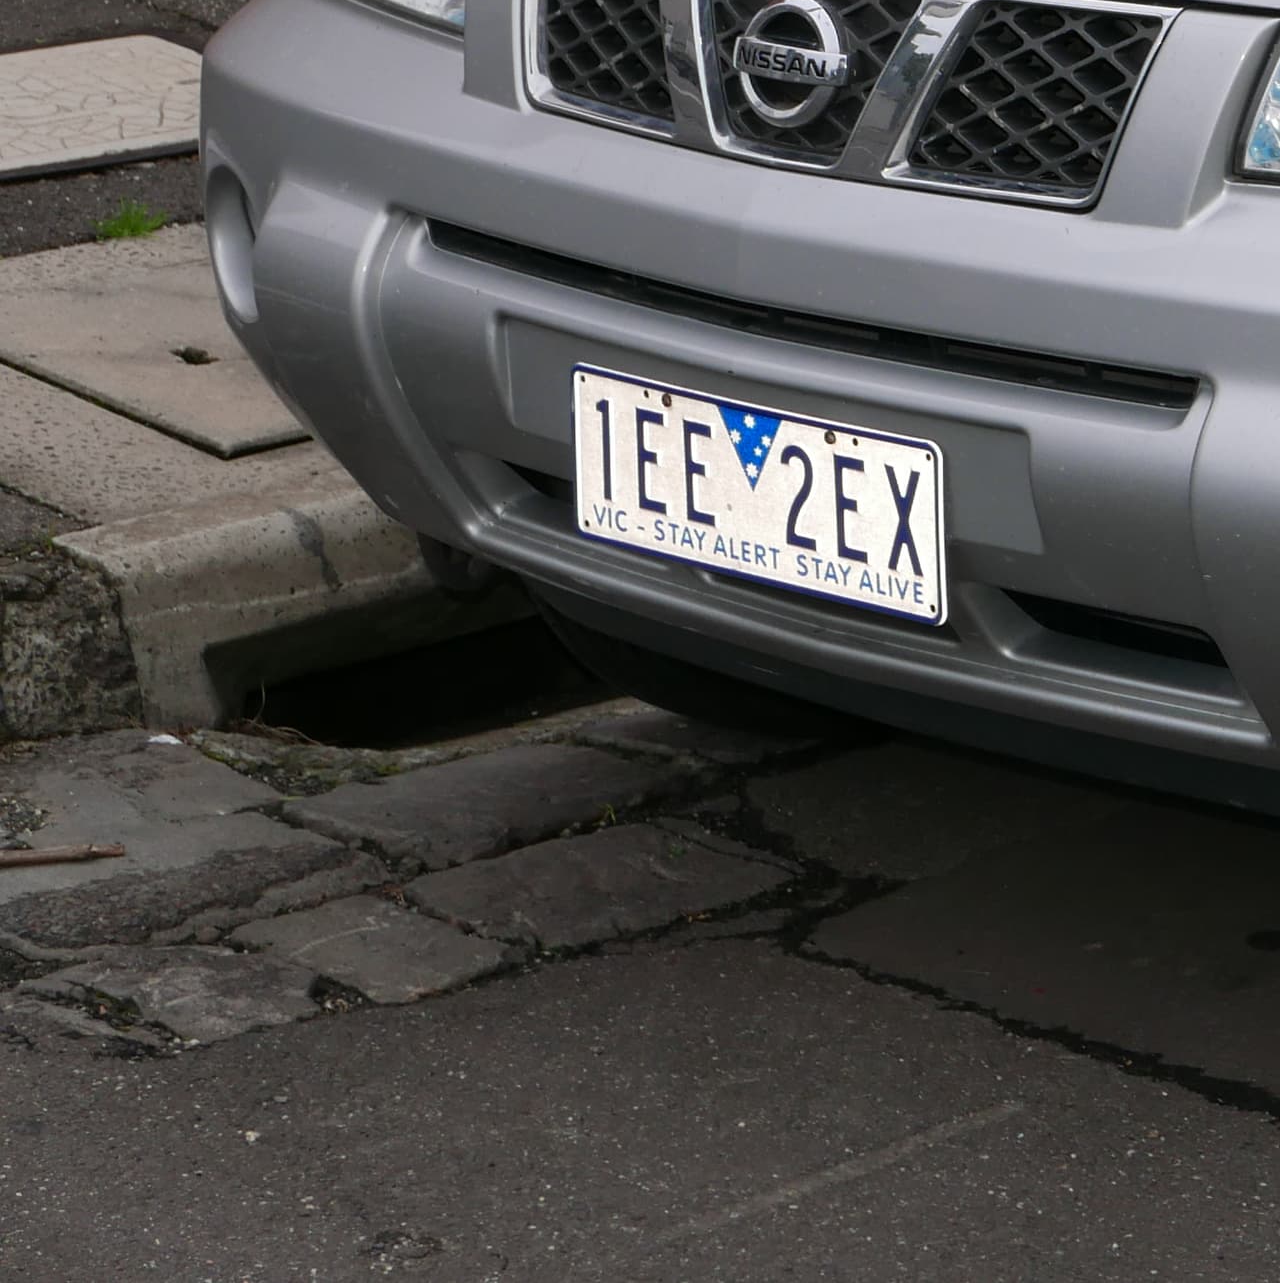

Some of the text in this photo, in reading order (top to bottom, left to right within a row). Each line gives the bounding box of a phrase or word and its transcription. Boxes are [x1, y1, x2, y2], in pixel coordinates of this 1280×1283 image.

[738, 45, 827, 78] NISSAN
[596, 398, 924, 577] 1EE 2EX
[593, 504, 628, 534] VIC
[654, 519, 708, 552] STAY
[713, 535, 780, 570] ALERT
[797, 554, 853, 588] STAY
[859, 570, 924, 604] ALIVE
